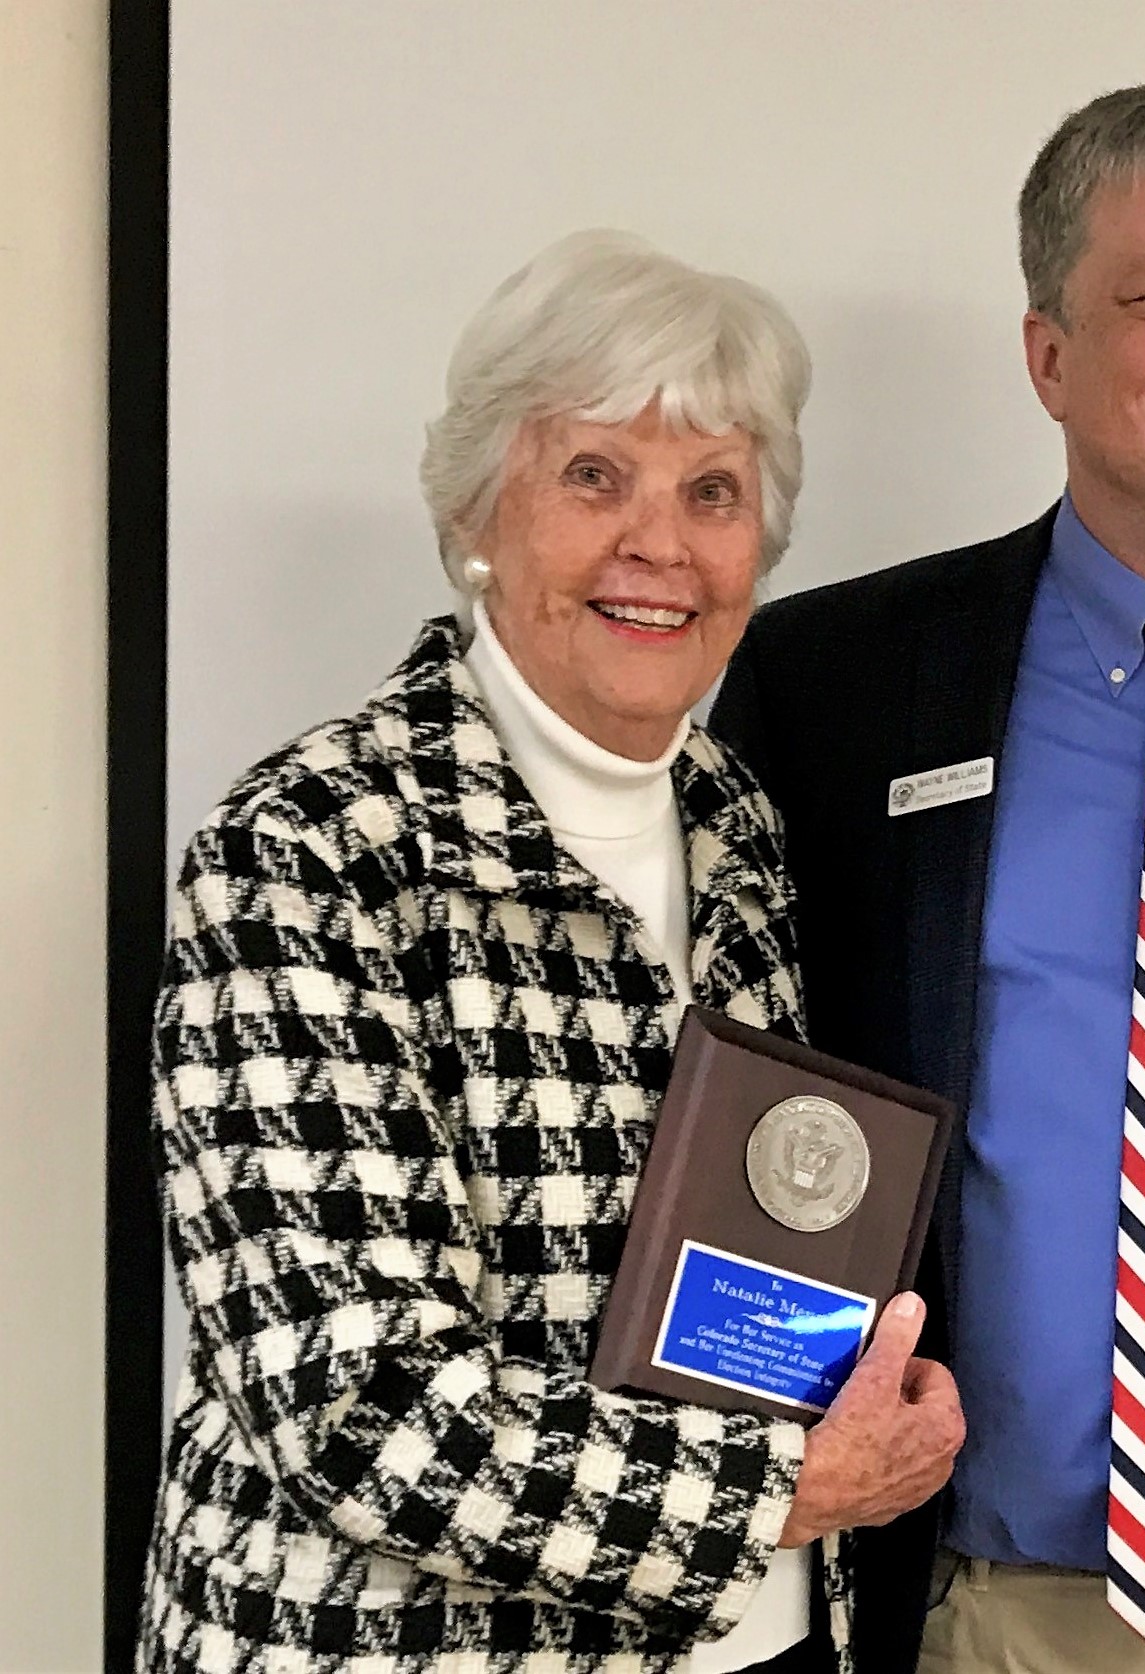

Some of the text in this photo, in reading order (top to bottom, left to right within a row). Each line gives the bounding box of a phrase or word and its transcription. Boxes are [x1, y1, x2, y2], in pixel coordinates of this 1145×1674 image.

[947, 764, 988, 782] WILLIAMS
[965, 781, 987, 792] State
[712, 1278, 775, 1309] Natalie
[679, 1336, 697, 1347] and
[724, 1318, 741, 1331] For
[742, 1324, 759, 1336] Her
[761, 1330, 792, 1348] Service
[697, 1325, 824, 1371] Colorado Secretary of State
